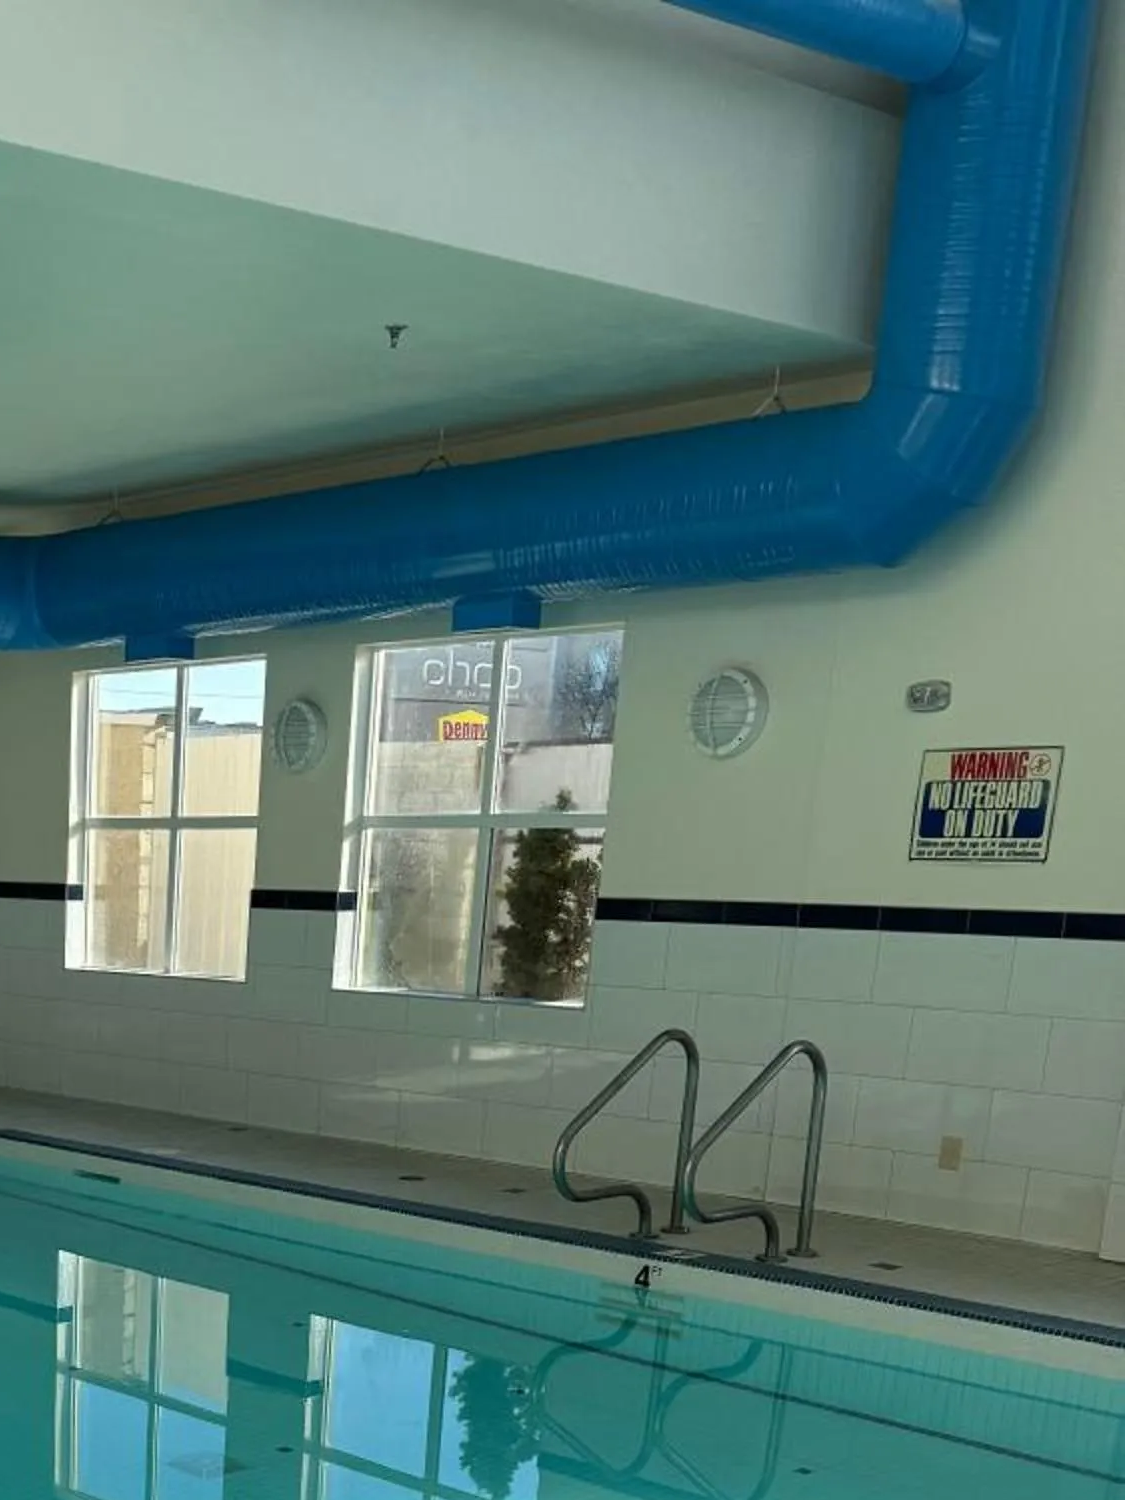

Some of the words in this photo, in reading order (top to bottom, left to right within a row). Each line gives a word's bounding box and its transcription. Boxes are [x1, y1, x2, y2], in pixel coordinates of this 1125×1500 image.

[442, 719, 488, 740] Denny
[950, 751, 1030, 780] WARNING
[928, 781, 952, 810] NO
[954, 781, 1044, 809] LIFEGUARD
[943, 809, 967, 837] ON
[971, 809, 1020, 837] DUTY
[634, 1264, 650, 1287] 4
